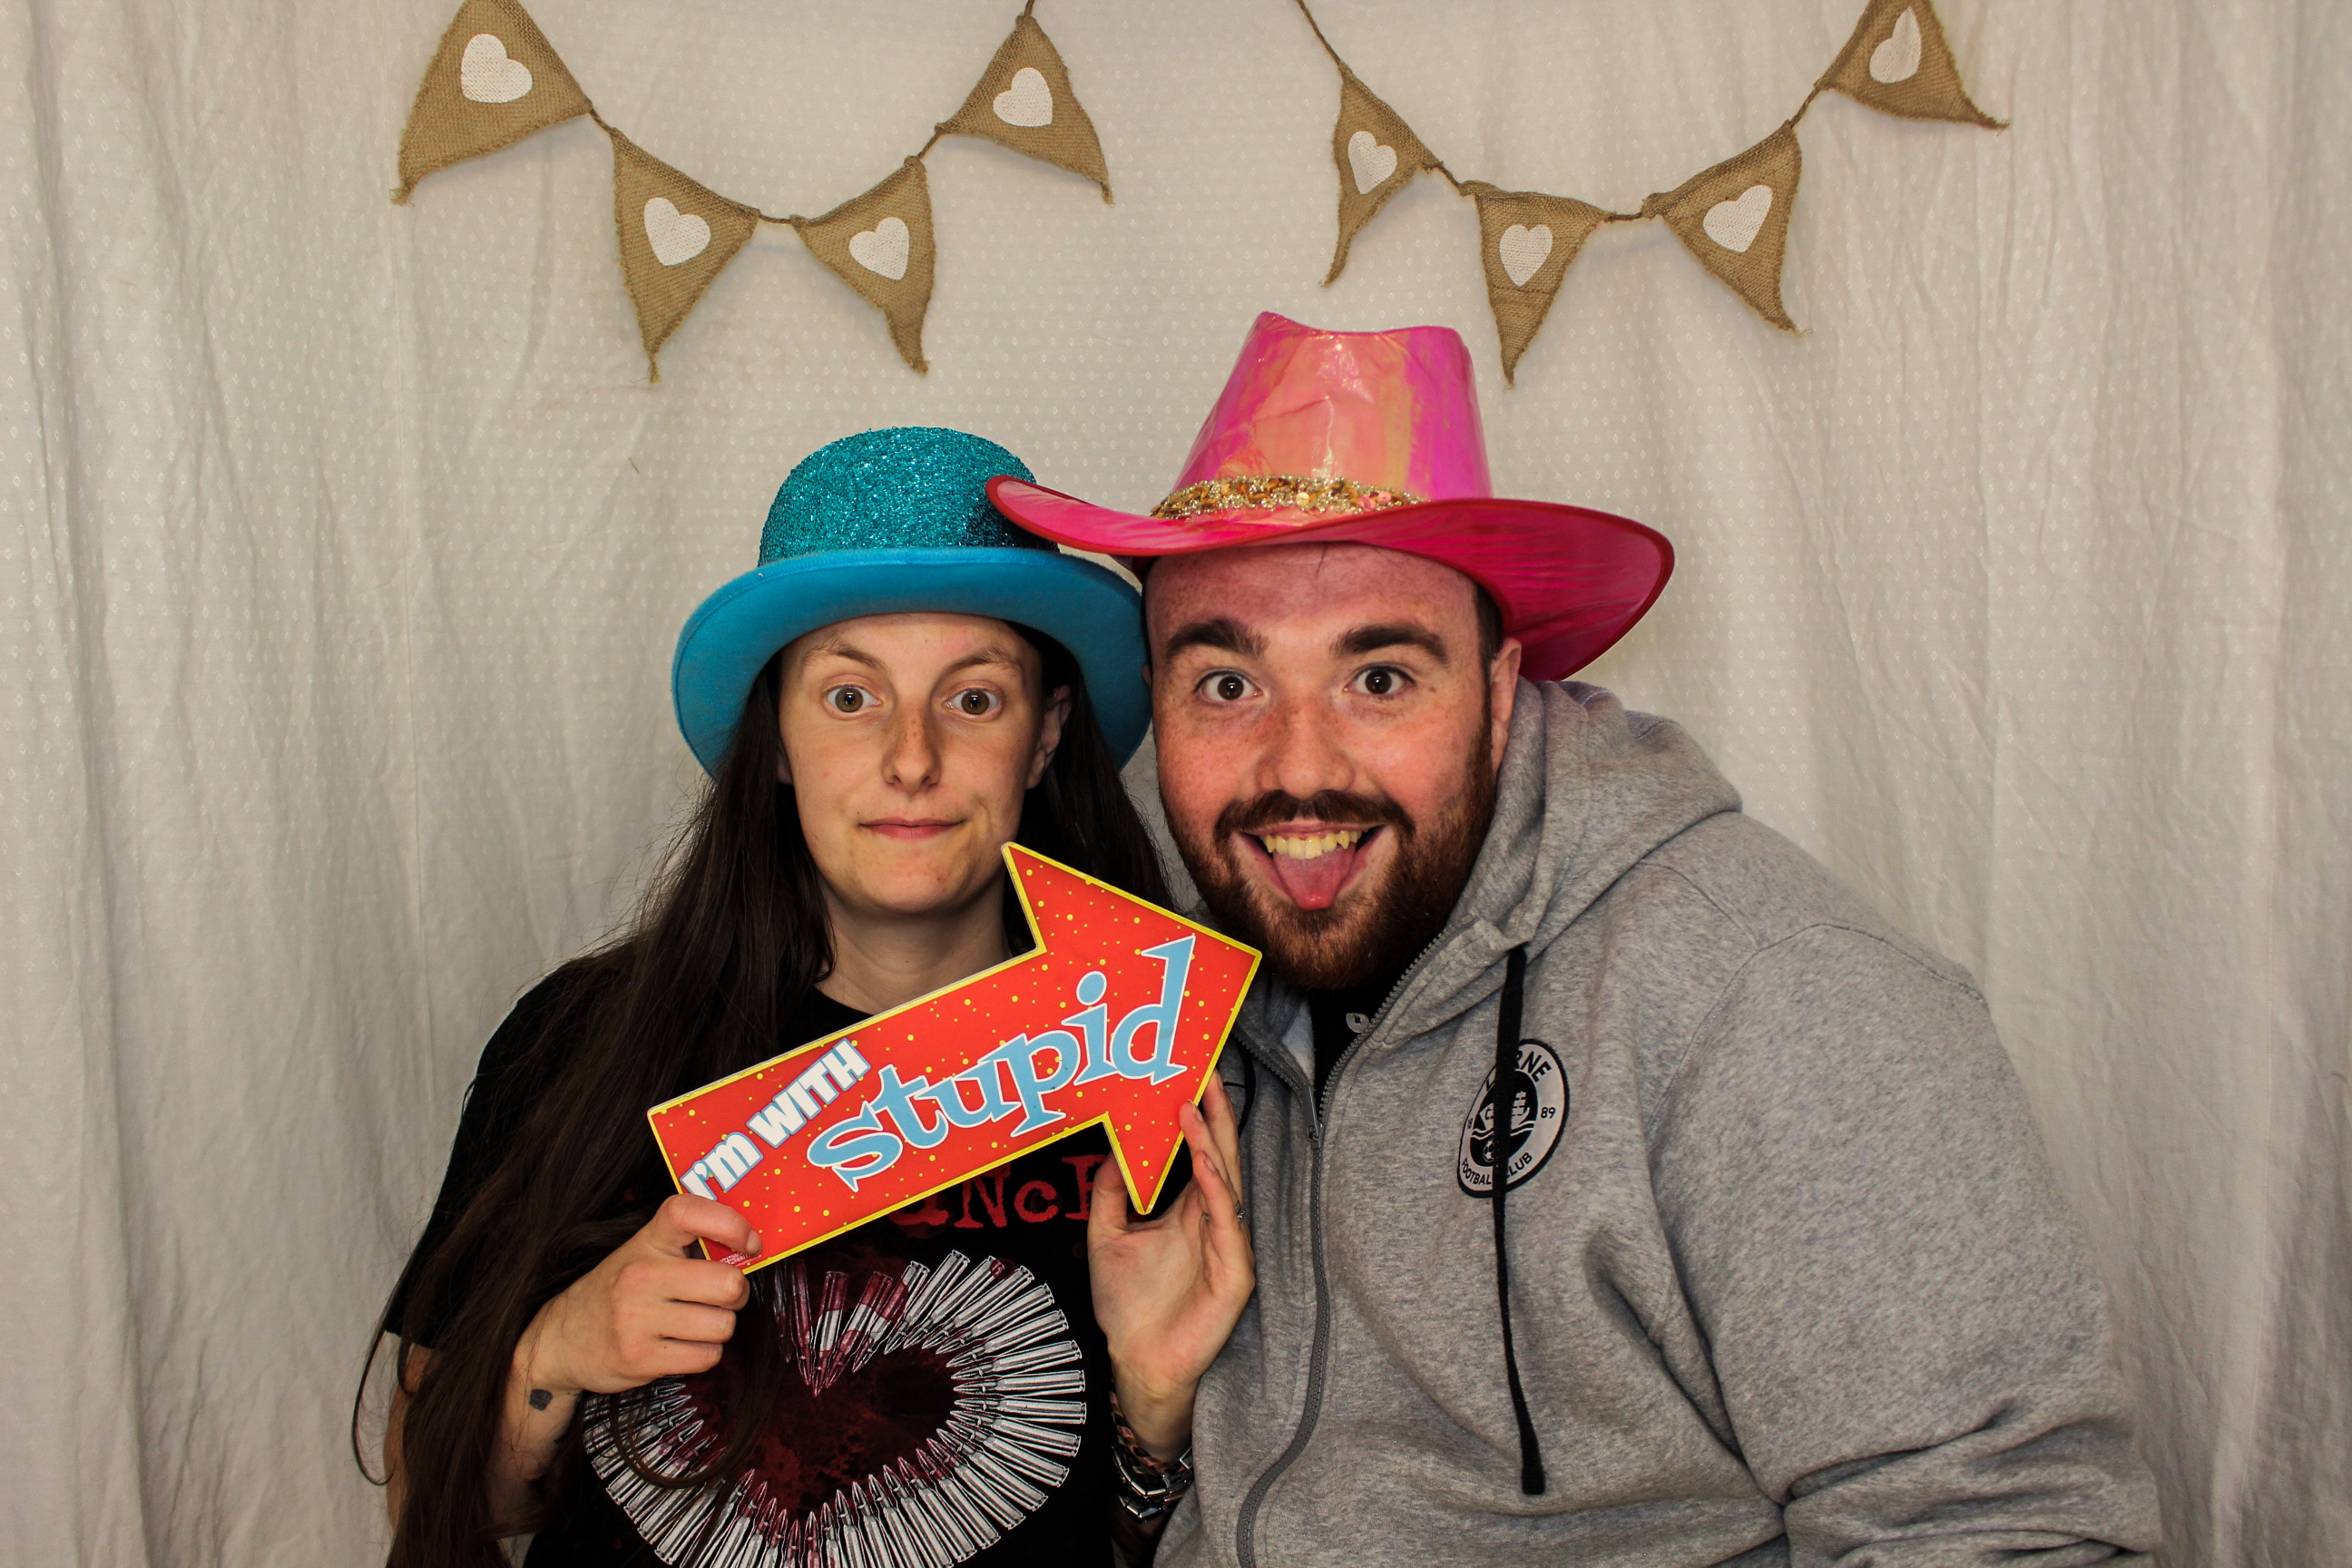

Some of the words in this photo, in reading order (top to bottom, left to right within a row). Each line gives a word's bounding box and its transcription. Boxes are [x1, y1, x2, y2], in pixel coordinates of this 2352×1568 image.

[1485, 1050, 1553, 1093] LRNE
[746, 1037, 871, 1148] WITH
[1540, 1106, 1556, 1120] 89
[1461, 1157, 1493, 1185] FOOTBAL
[1506, 1152, 1533, 1178] LUB
